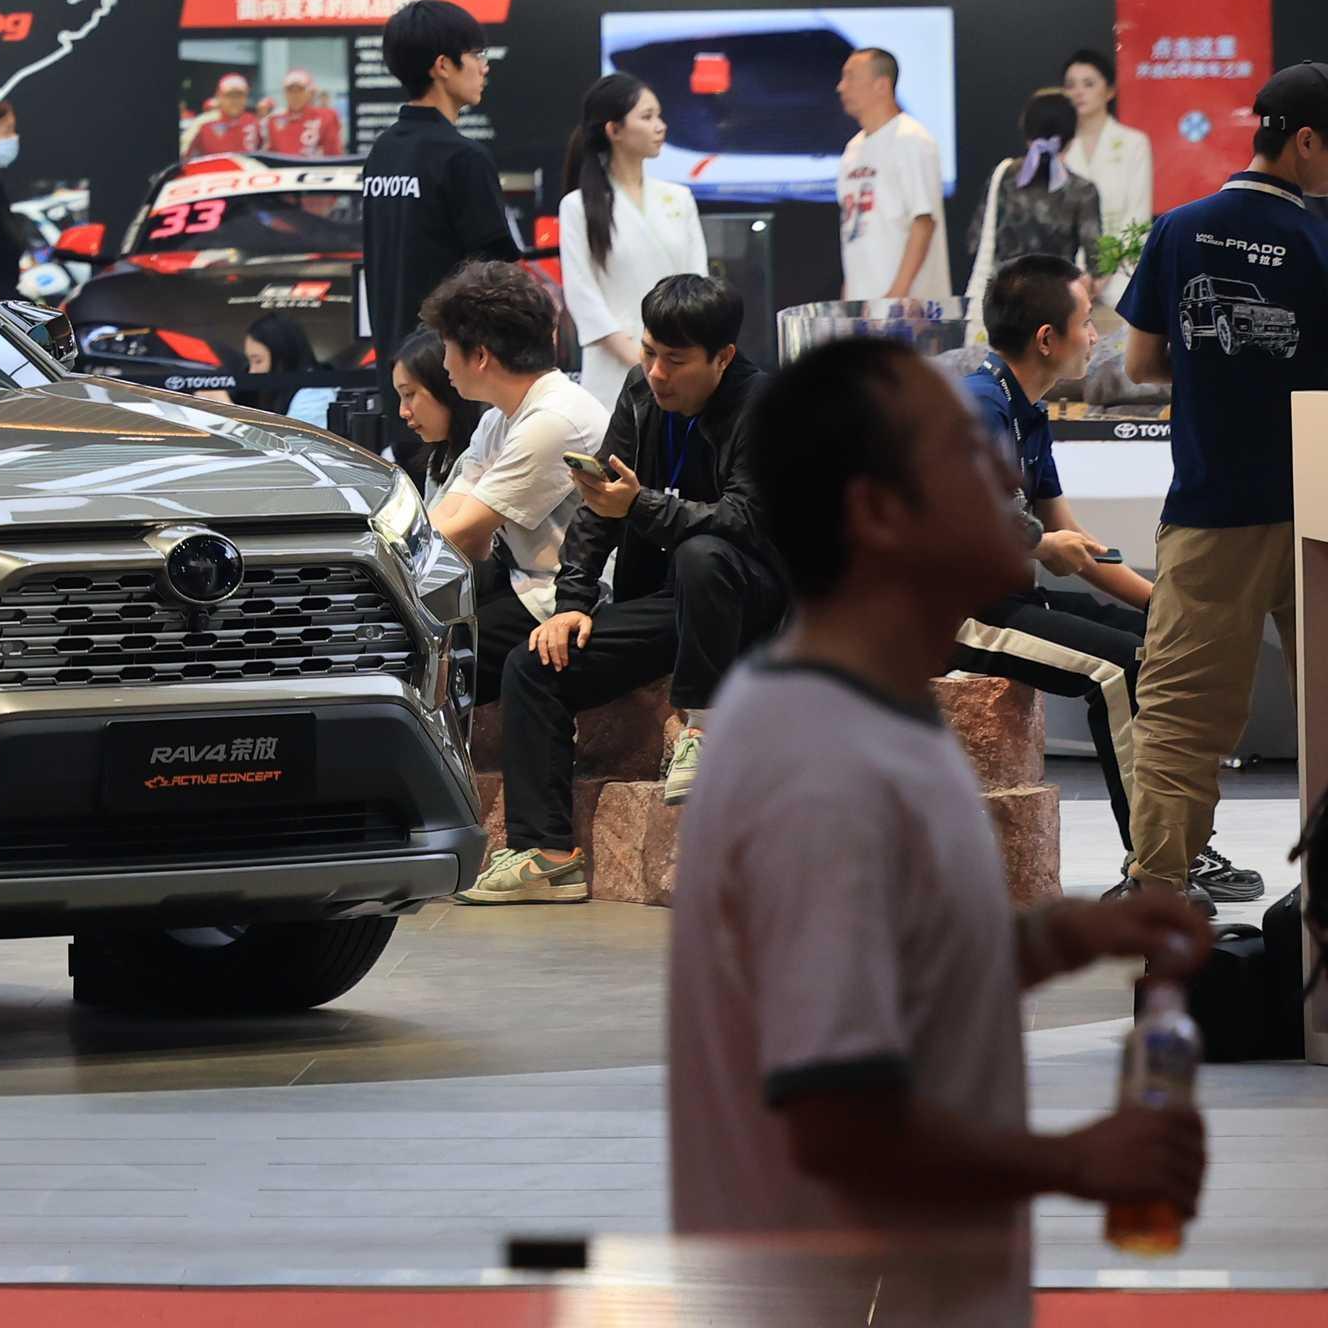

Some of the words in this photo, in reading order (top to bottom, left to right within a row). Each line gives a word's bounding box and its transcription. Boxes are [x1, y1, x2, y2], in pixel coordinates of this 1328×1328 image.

[362, 175, 421, 198] TOYOTA
[148, 199, 227, 240] 33
[1225, 238, 1287, 256] PRADO
[1247, 253, 1284, 267] 普拉多
[185, 375, 237, 389] TOYOTA
[1138, 424, 1170, 437] TOY
[150, 743, 226, 765] RAV4
[229, 736, 280, 762] 荣放
[170, 773, 218, 786] ACTIVE
[219, 770, 283, 785] CONCEPT
